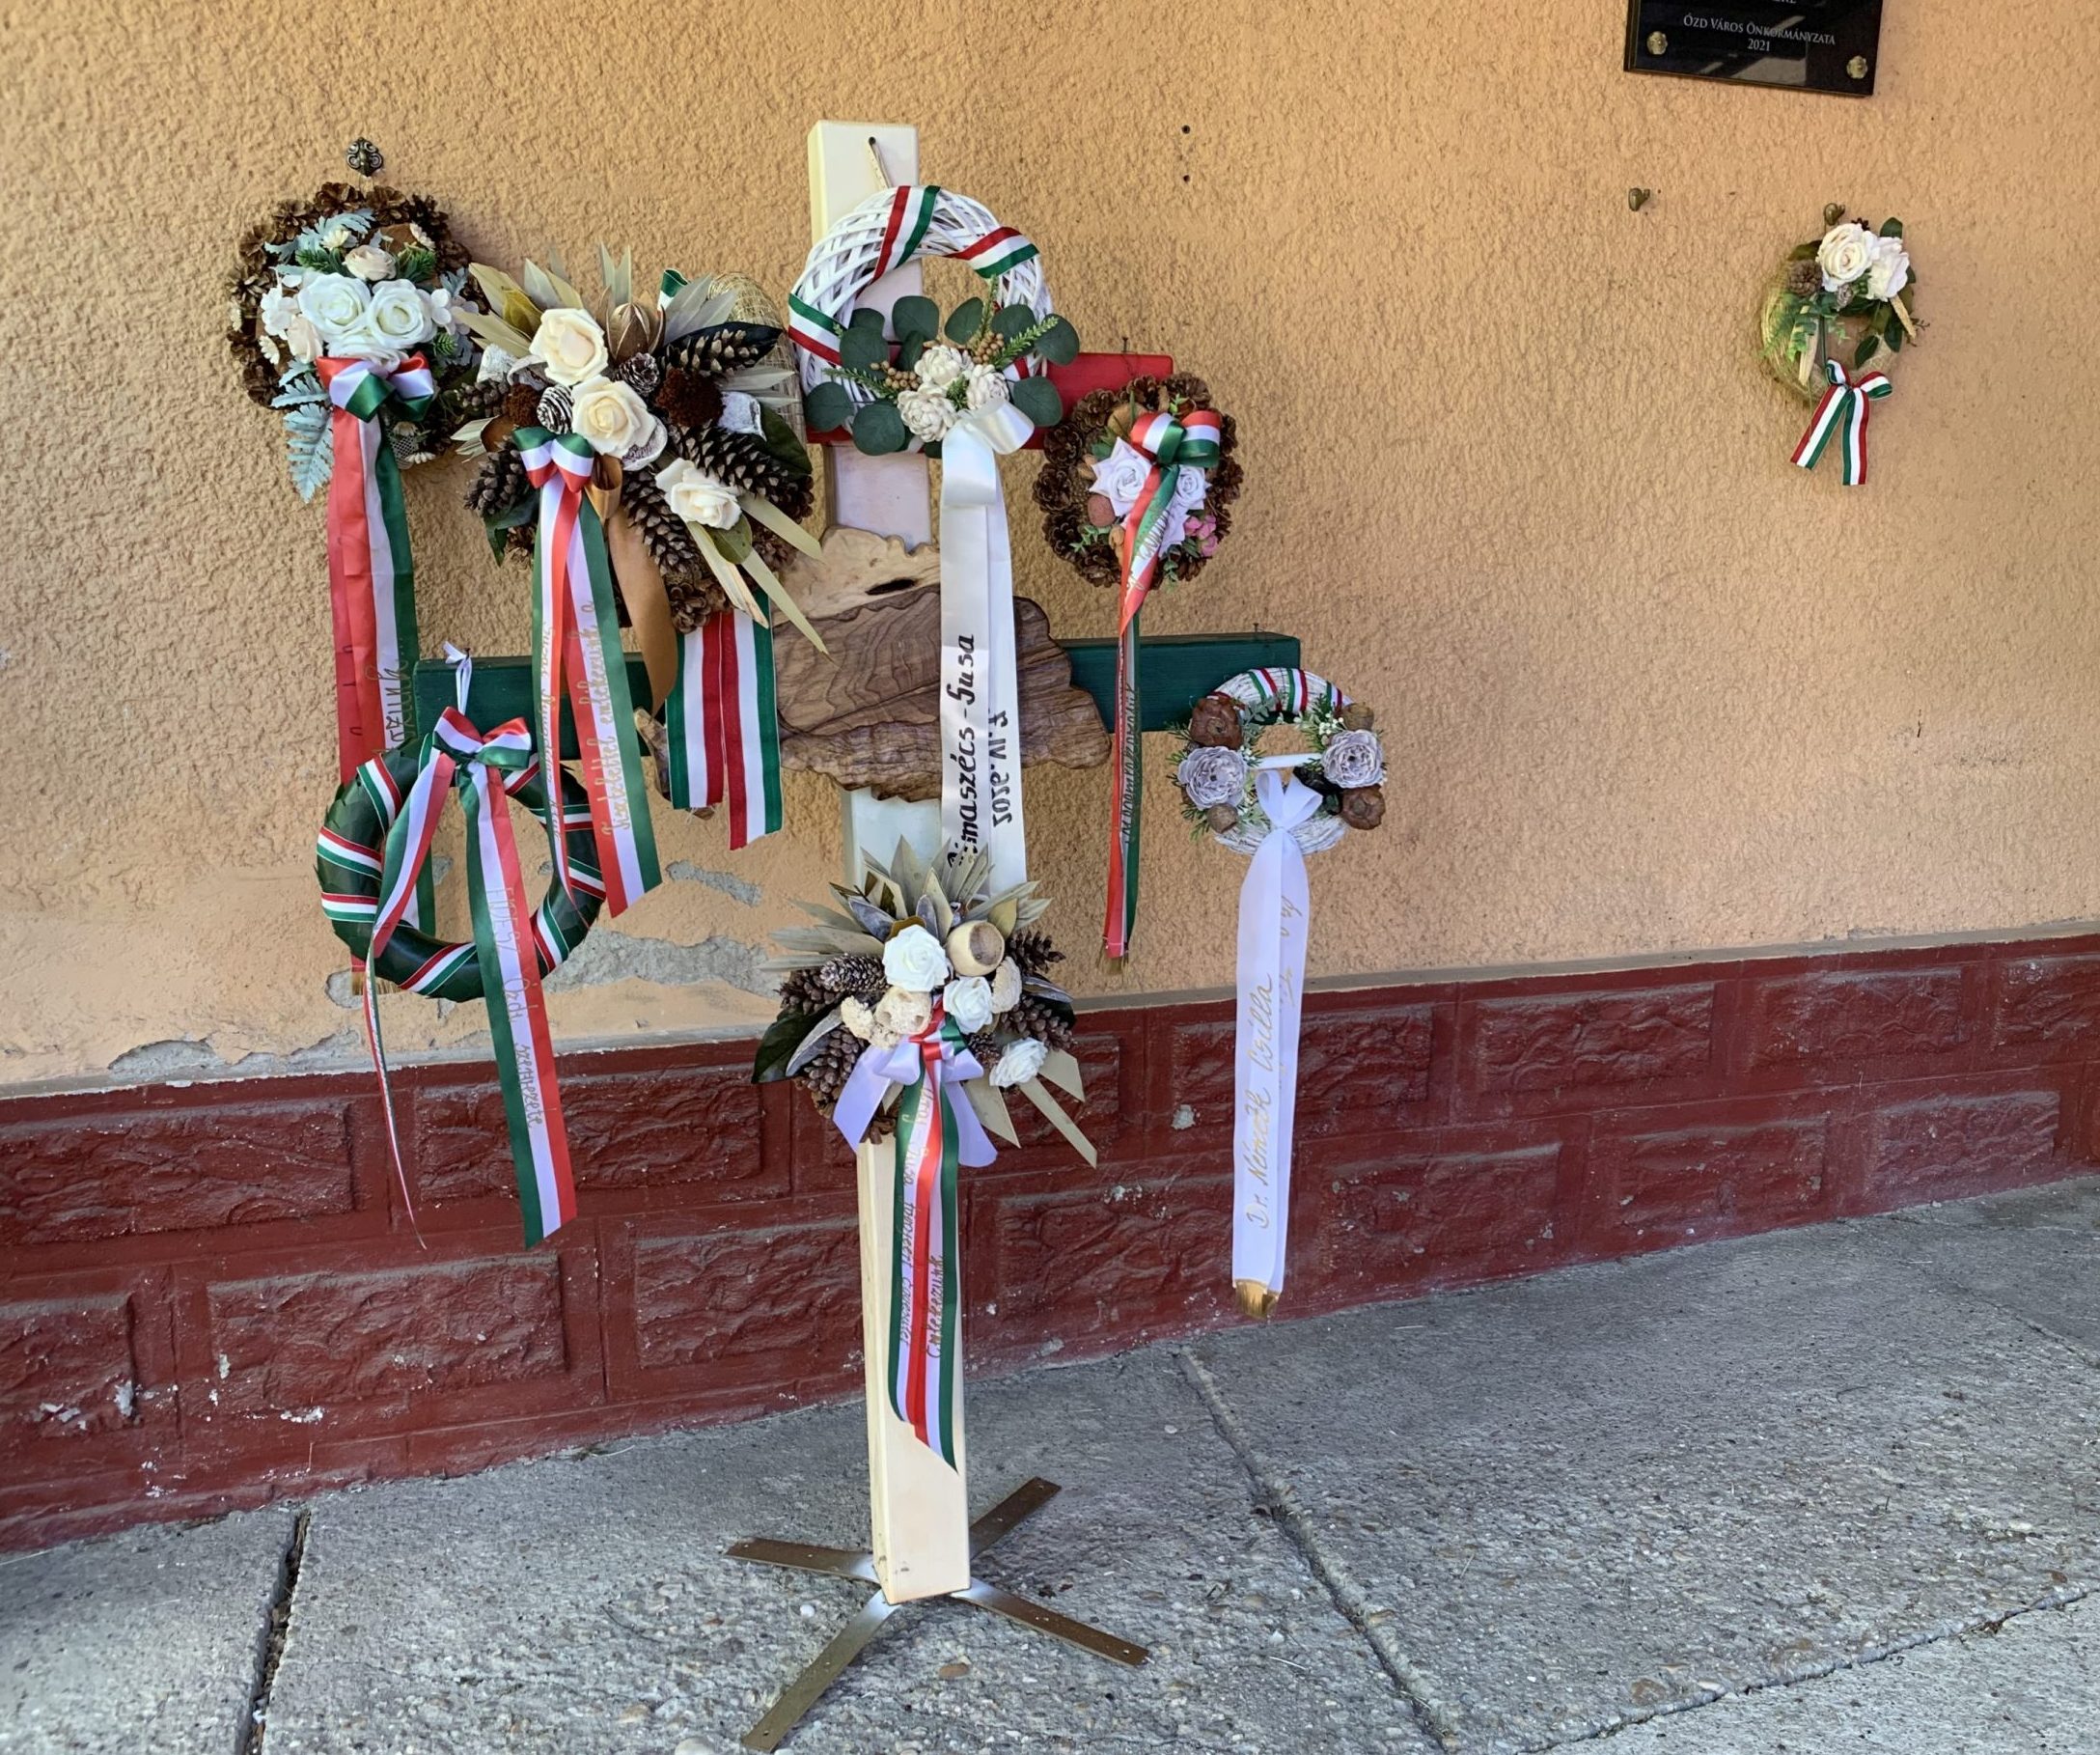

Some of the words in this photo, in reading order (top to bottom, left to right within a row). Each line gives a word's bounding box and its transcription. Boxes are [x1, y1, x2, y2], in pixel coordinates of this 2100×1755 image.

[1683, 13, 1708, 29] ÓZD
[1711, 17, 1744, 34] VÁROS
[1747, 38, 1771, 52] 2021
[1243, 973, 1274, 1072] Csilla
[1245, 1195, 1269, 1229] Dr.
